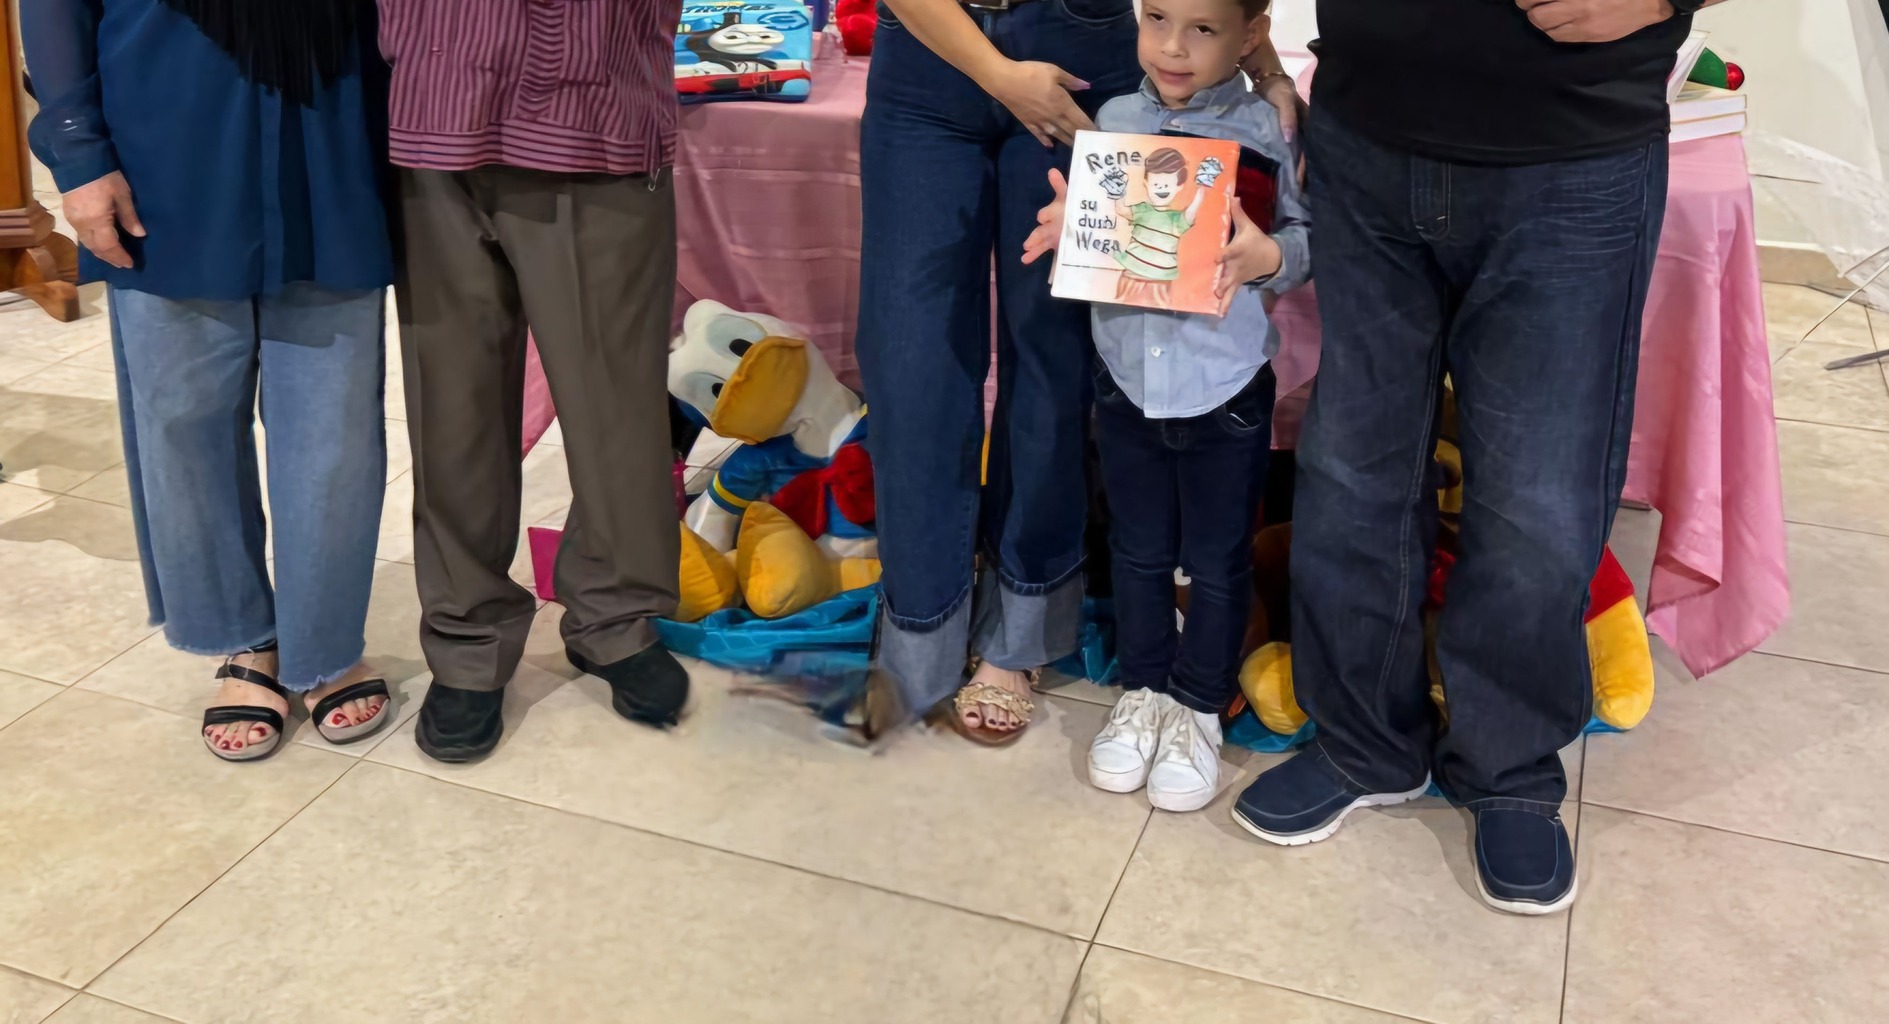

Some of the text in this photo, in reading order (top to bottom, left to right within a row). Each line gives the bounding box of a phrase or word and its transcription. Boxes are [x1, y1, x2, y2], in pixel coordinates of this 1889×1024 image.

[1085, 150, 1142, 173] Rene
[1080, 199, 1098, 211] su
[1076, 230, 1121, 254] Wega
